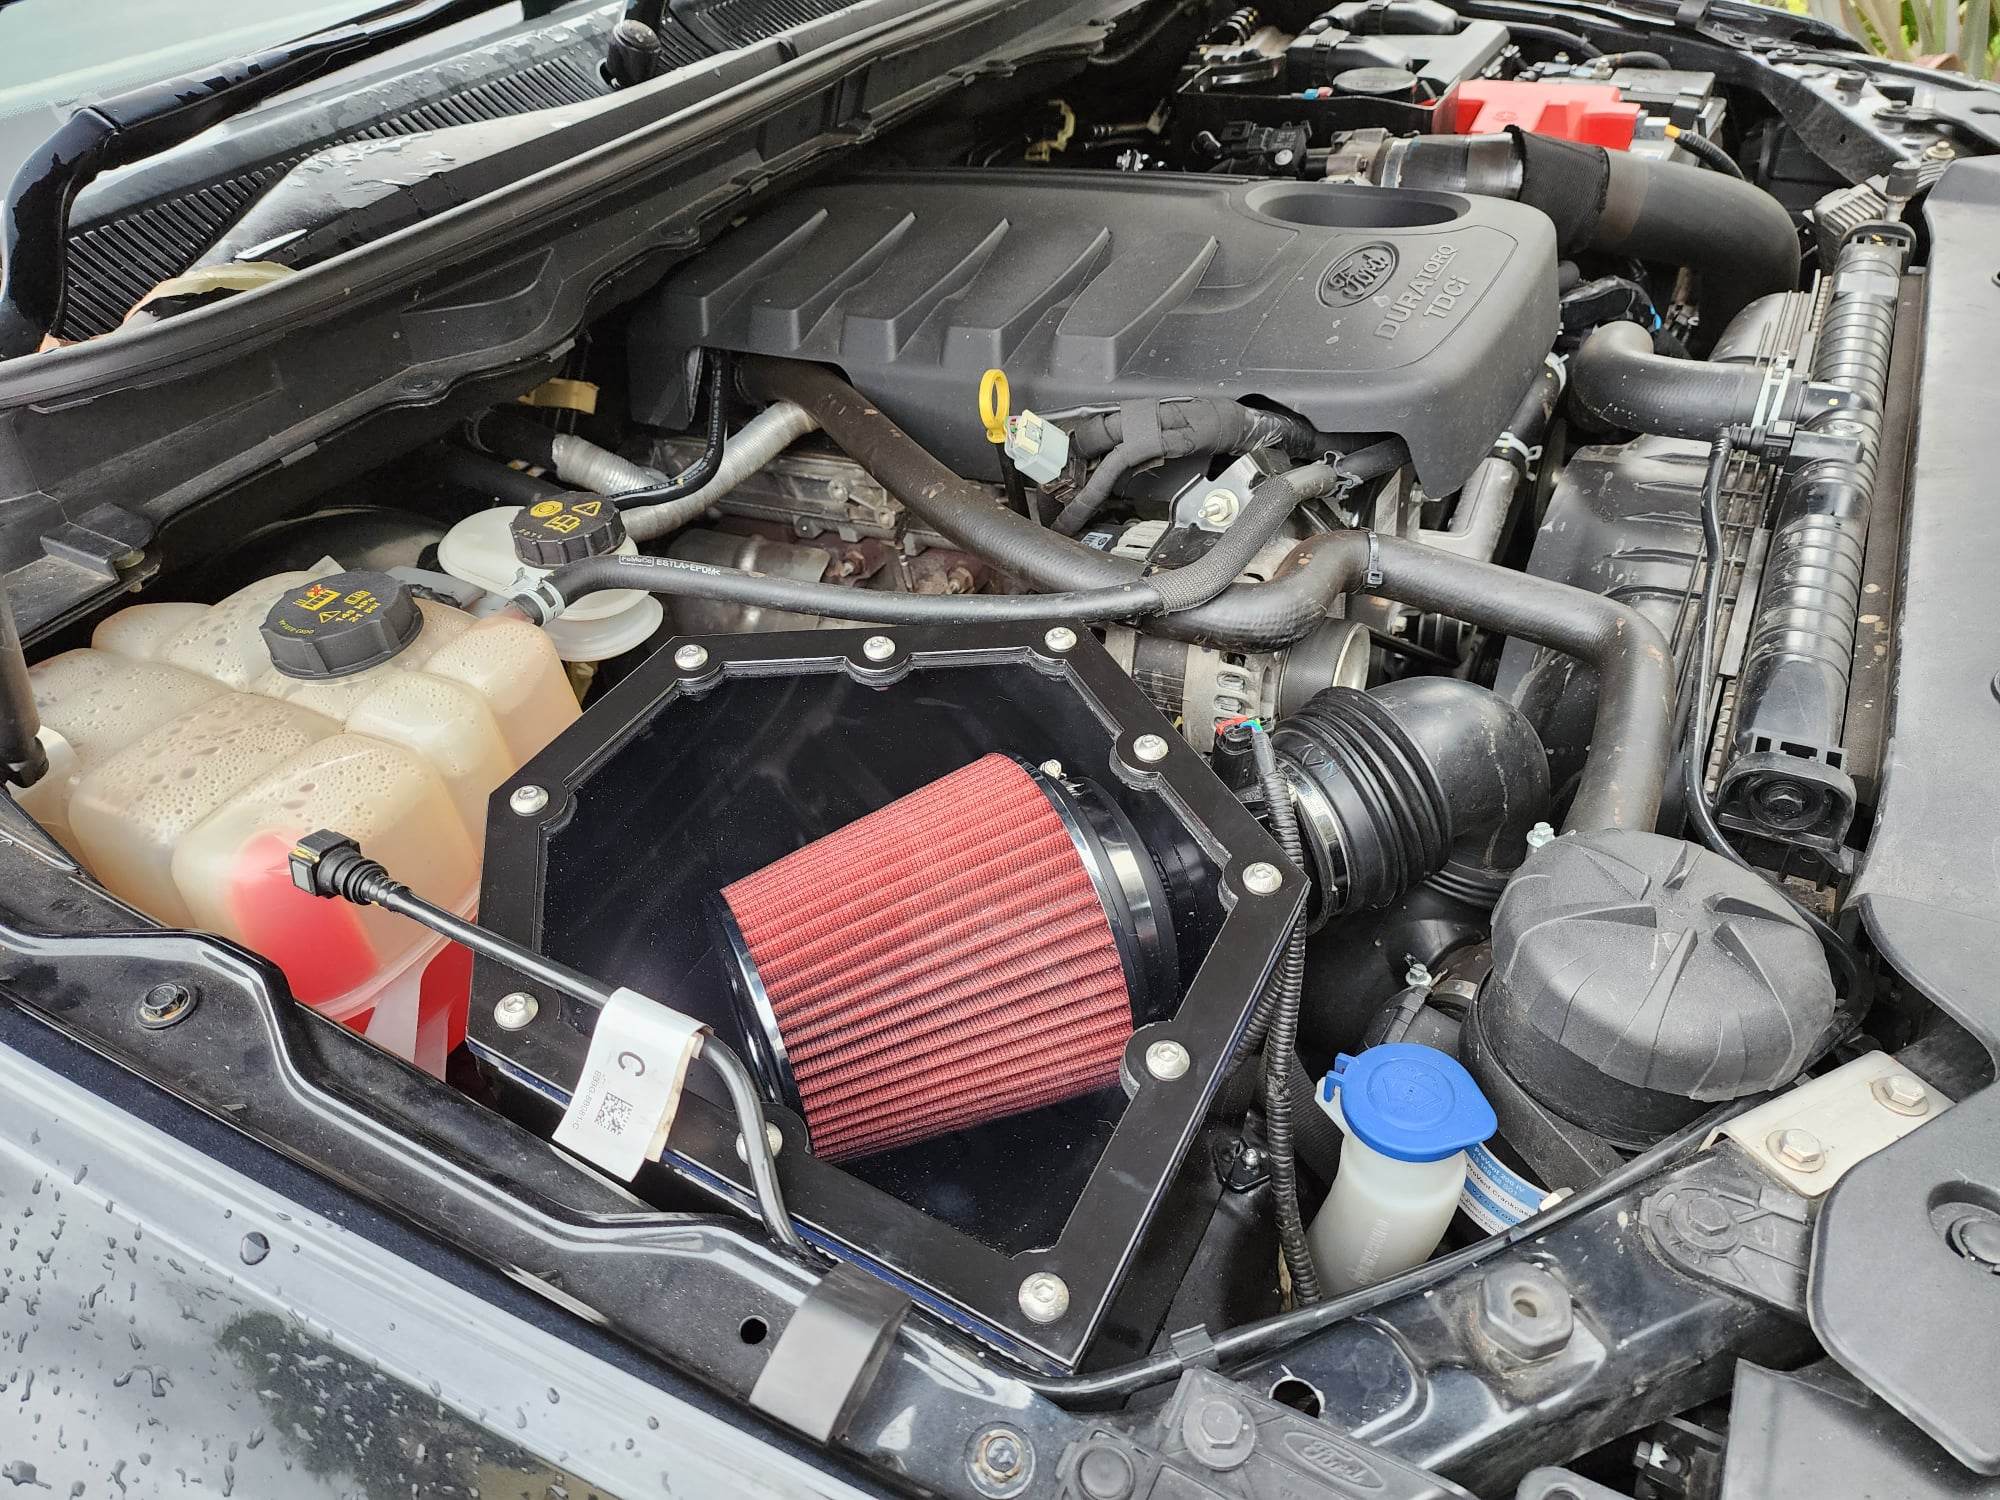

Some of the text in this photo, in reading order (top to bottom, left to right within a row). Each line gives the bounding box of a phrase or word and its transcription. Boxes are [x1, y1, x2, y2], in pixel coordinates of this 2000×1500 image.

[1326, 253, 1390, 300] Ford
[1373, 244, 1458, 340] DURATORQ
[1423, 275, 1470, 319] TDCi
[617, 1051, 646, 1077] C
[1466, 1162, 1491, 1190] ProVent
[1474, 1146, 1500, 1176] ProVent
